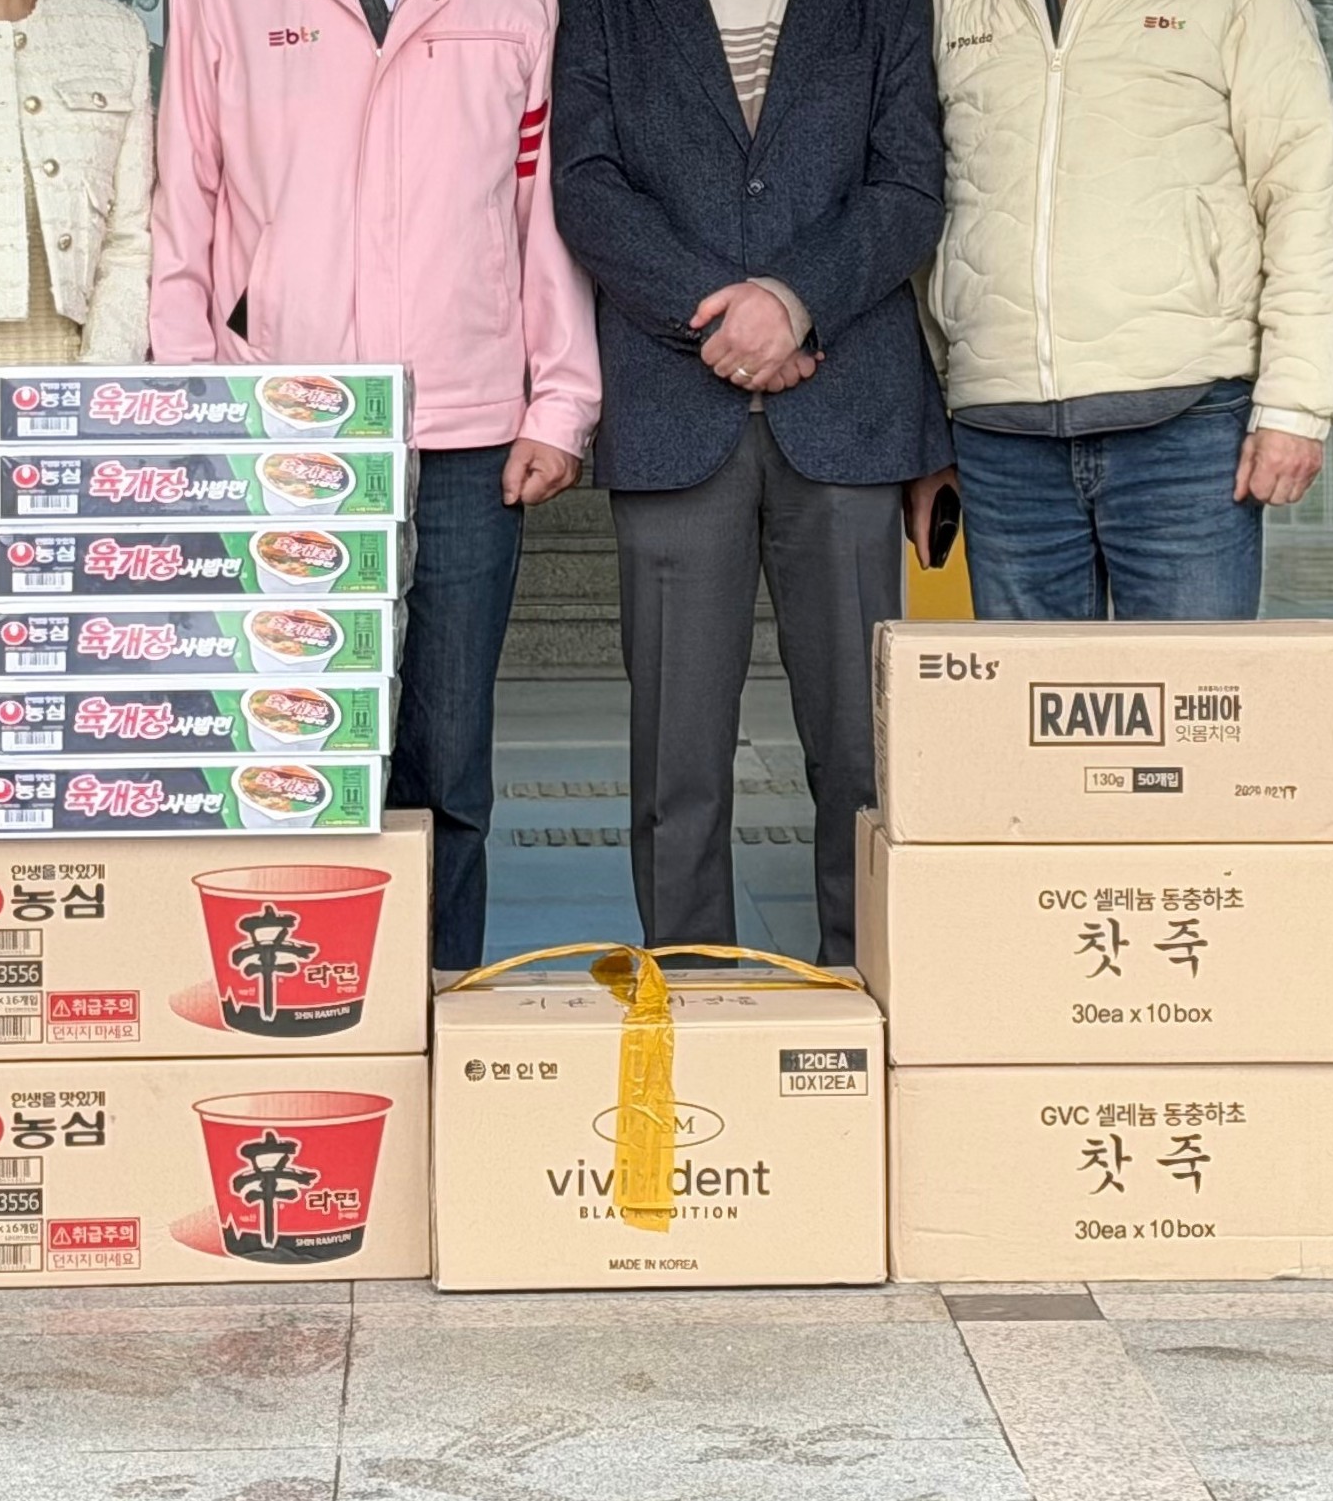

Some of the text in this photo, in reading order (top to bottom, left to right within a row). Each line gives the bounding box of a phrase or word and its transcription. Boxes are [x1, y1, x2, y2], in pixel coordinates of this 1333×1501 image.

[41, 390, 81, 408] 농심
[89, 383, 247, 426] 육개장 사발면
[41, 468, 81, 486] 농심
[89, 460, 248, 503] 육개장 사발면
[35, 546, 76, 564] 농심
[84, 538, 242, 581] 육개장 사발면
[29, 625, 69, 643] 농심
[77, 617, 237, 660] 육개장 사발면
[25, 704, 65, 722] 농심
[74, 696, 234, 739] 육개장 사발면
[1039, 691, 1154, 737] RAVIA
[1174, 694, 1242, 723] 라비아
[1175, 725, 1242, 743] 잇몸치약
[1091, 772, 1126, 789] 130g
[1137, 771, 1180, 788] 50개입
[15, 781, 56, 800] 농심
[65, 774, 224, 818] 육개장 사발면
[58, 863, 106, 880] 맛있게
[10, 883, 106, 921] 농심
[1039, 887, 1245, 911] GVC 셀레늄 동충하초
[1153, 918, 1209, 979] 죽
[230, 903, 318, 1022] 辛
[304, 962, 361, 986] 라면
[71, 997, 134, 1017] 취급주의
[1072, 1004, 1124, 1024] 30ea
[52, 1024, 135, 1041] 던지지 마세요
[797, 1052, 849, 1071] 120EA
[789, 1074, 857, 1091] 10X12EA
[58, 1090, 106, 1108] 맛있게
[1040, 1102, 1247, 1127] GVC 셀레늄 동충하초
[10, 1110, 106, 1148] 농심
[1155, 1133, 1211, 1194] 죽
[232, 1128, 321, 1249] 辛
[305, 1189, 362, 1214] 라면
[71, 1224, 134, 1245] 취급주의
[1074, 1220, 1126, 1240] 30ea
[52, 1252, 135, 1269] 던지지 마세요
[609, 1258, 698, 1271] MADE IN KOREA
